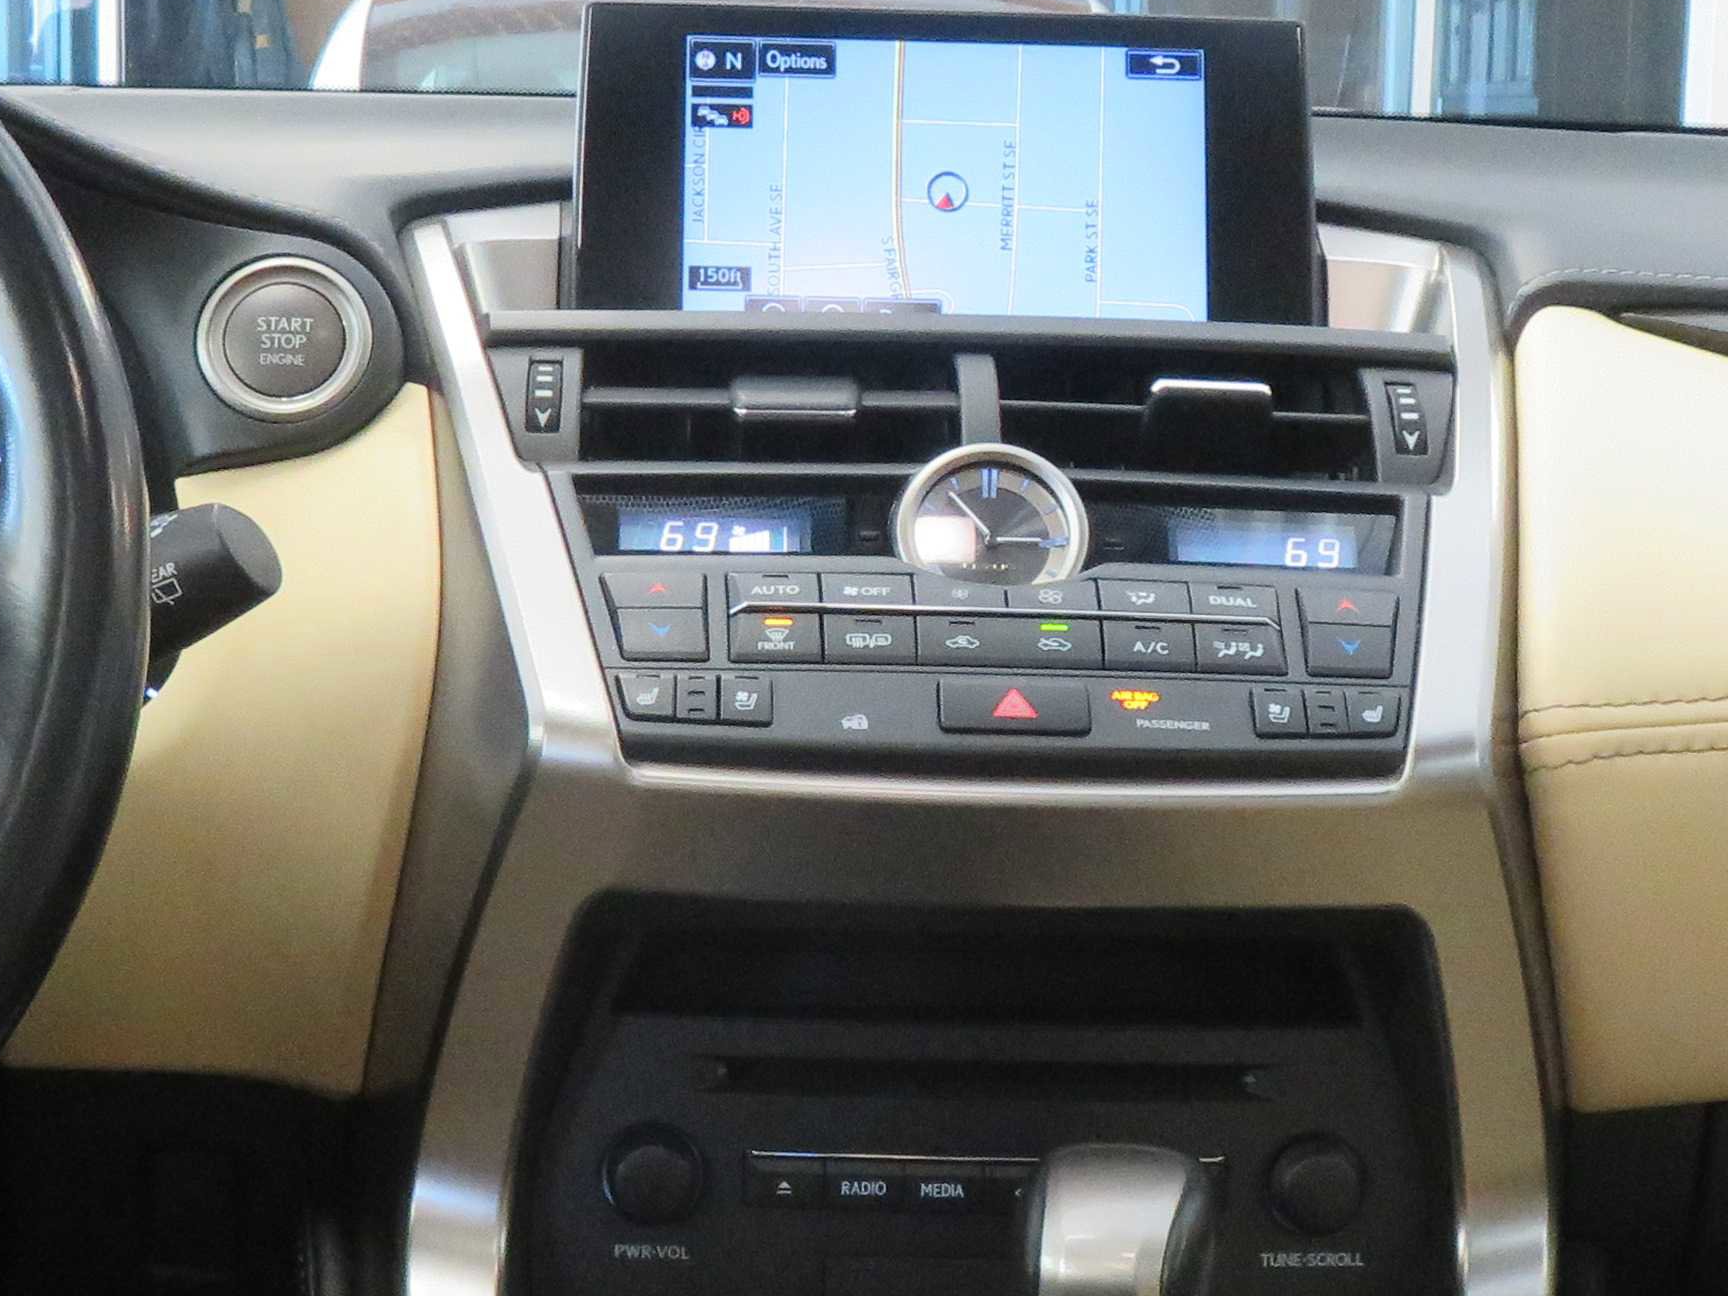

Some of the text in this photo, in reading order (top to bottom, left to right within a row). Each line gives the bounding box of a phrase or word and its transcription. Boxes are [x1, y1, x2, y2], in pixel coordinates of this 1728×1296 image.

[725, 52, 743, 71] N
[765, 49, 829, 73] Options
[692, 153, 706, 224] JACKSON
[770, 184, 783, 199] SE
[1000, 140, 1017, 252] MERRITT ST SE
[769, 207, 783, 235] AVE
[1084, 200, 1100, 283] PARK ST SE
[698, 268, 742, 283] 150ft
[256, 316, 314, 333] START
[260, 333, 307, 349] STOP
[259, 352, 305, 366] ENGINE
[659, 521, 719, 552] 69
[1284, 537, 1341, 569] 69
[152, 562, 178, 583] EAR
[751, 585, 800, 595] AUTO
[860, 586, 892, 596] OFF
[1208, 595, 1257, 608] DUAL
[757, 640, 796, 651] FRONT
[1133, 641, 1169, 655] A/C
[1122, 700, 1150, 710] OFF
[1135, 718, 1211, 732] PASSENGER
[840, 1180, 888, 1197] RADIO
[920, 1182, 965, 1199] MEDIA
